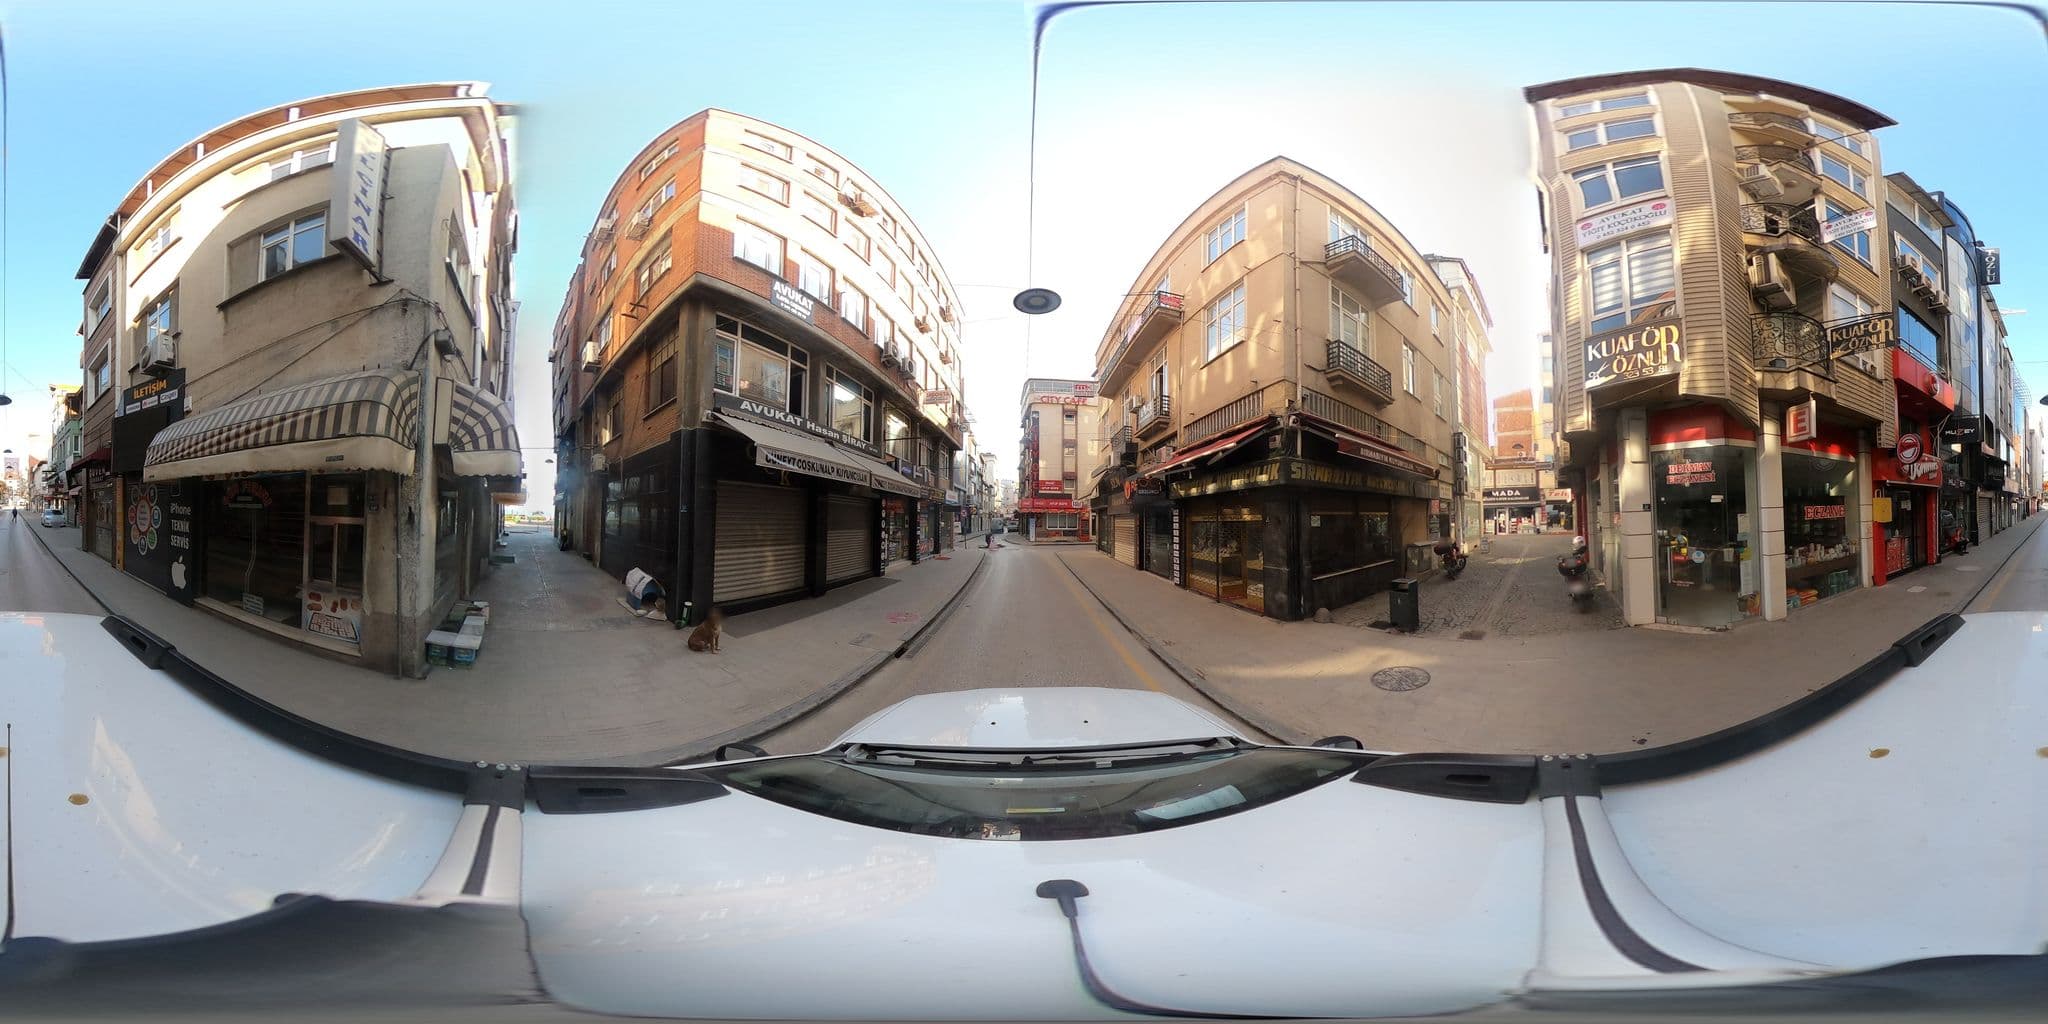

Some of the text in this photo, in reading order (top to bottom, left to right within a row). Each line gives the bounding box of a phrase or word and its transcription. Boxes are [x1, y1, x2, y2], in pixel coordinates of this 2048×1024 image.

[1600, 208, 1643, 223] AVUKAT
[1985, 249, 1996, 283] TOZLU
[773, 281, 814, 311] AVUKAT
[1832, 319, 1894, 342] KUAFÖR
[1588, 325, 1680, 364] KUAFÖR
[1642, 366, 1654, 376] 53
[133, 379, 167, 399] İLETİŞİM
[1040, 395, 1088, 405] CITY CAFE
[740, 400, 866, 449] AVUKAT Hasan ŞİRAY
[1793, 409, 1806, 434] E
[1668, 462, 1712, 474] DERMAN
[1492, 489, 1521, 497] MADA
[1805, 505, 1846, 520] ECZANE
[171, 519, 190, 533] TEKNİK
[171, 535, 189, 549] SERVİS
